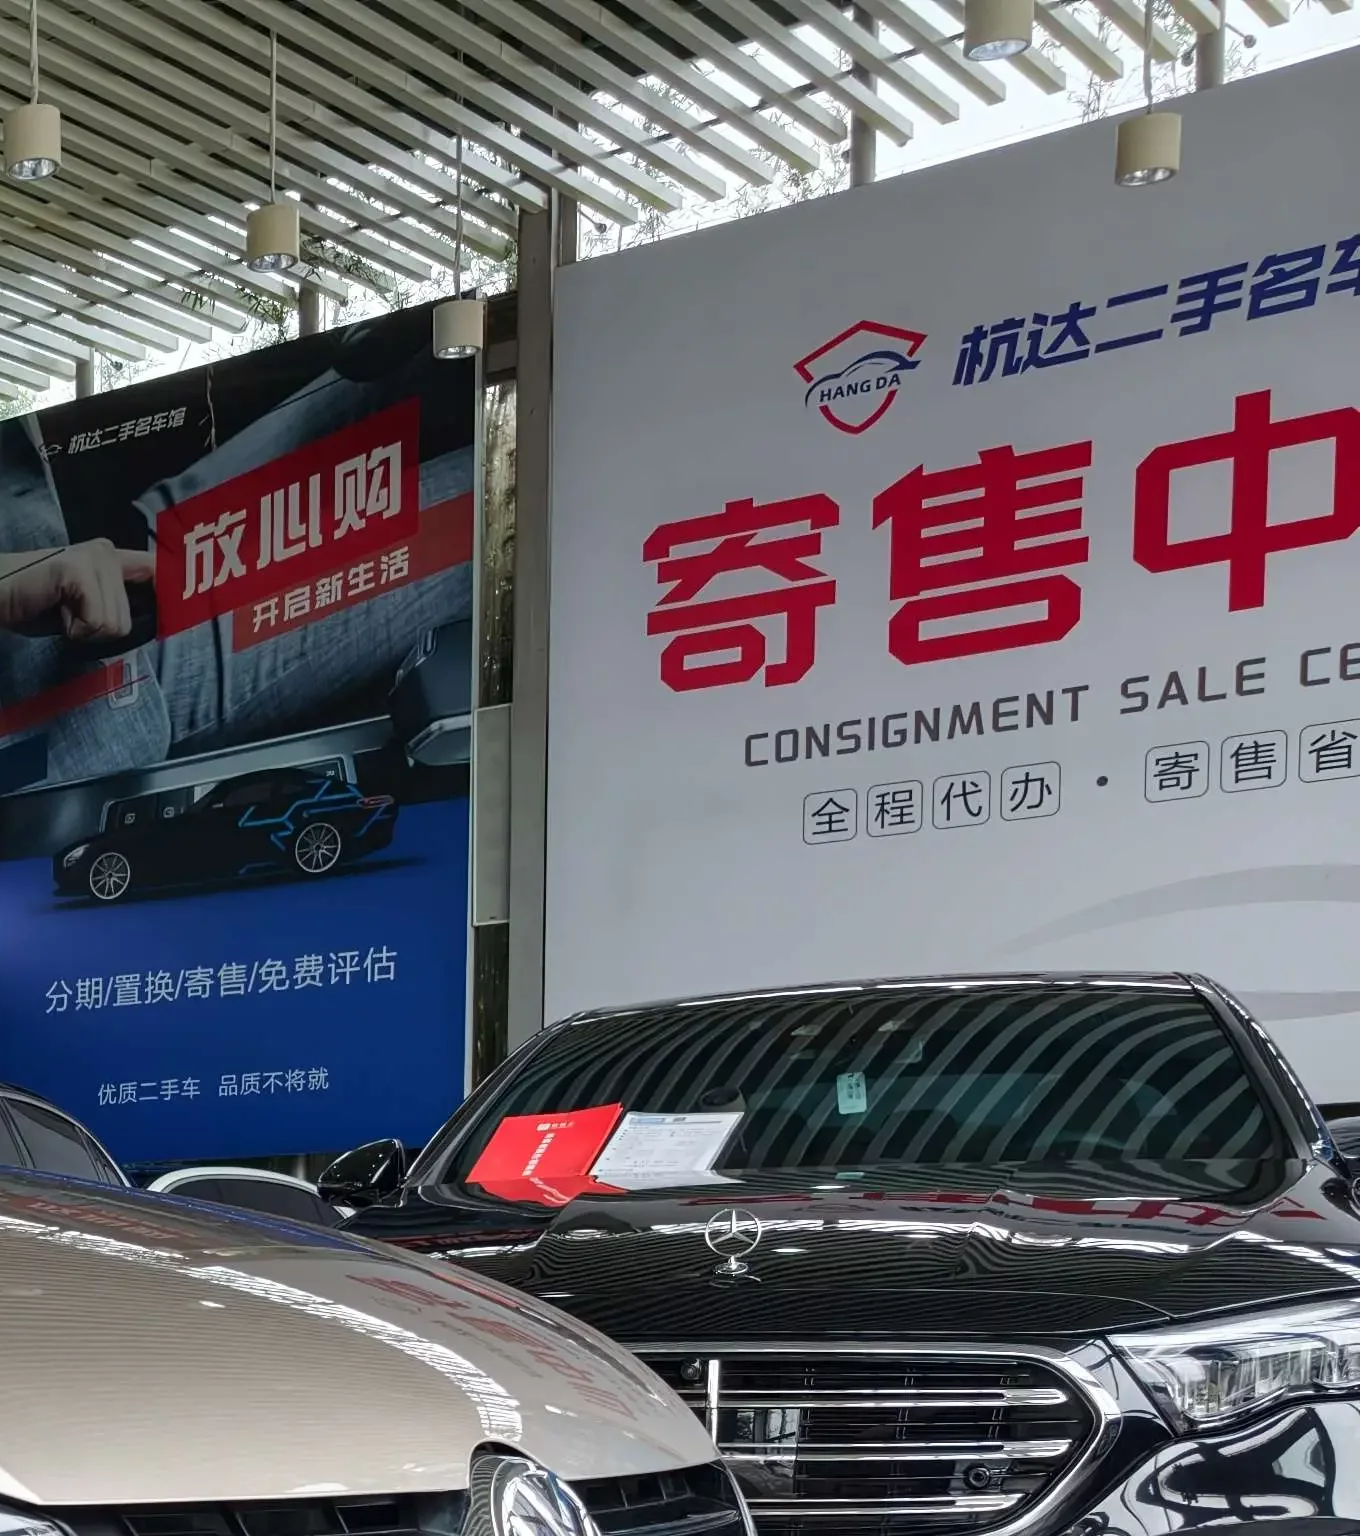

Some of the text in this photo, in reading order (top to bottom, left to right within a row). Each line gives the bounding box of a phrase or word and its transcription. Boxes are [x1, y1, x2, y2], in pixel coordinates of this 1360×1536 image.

[67, 406, 187, 454] 杭达二手名车馆
[818, 371, 902, 403] HANG DA
[182, 440, 403, 600] 放心购
[642, 388, 1360, 694] 寄售中
[252, 546, 410, 633] 开启新生活
[743, 641, 1360, 769] CONSIGNMENT SALE CE
[810, 728, 1360, 838] 全程代办 寄售省
[45, 945, 398, 1014] 分期/置换/寄售/免费评估
[98, 1066, 330, 1106] 优质二手车 品质不将就
